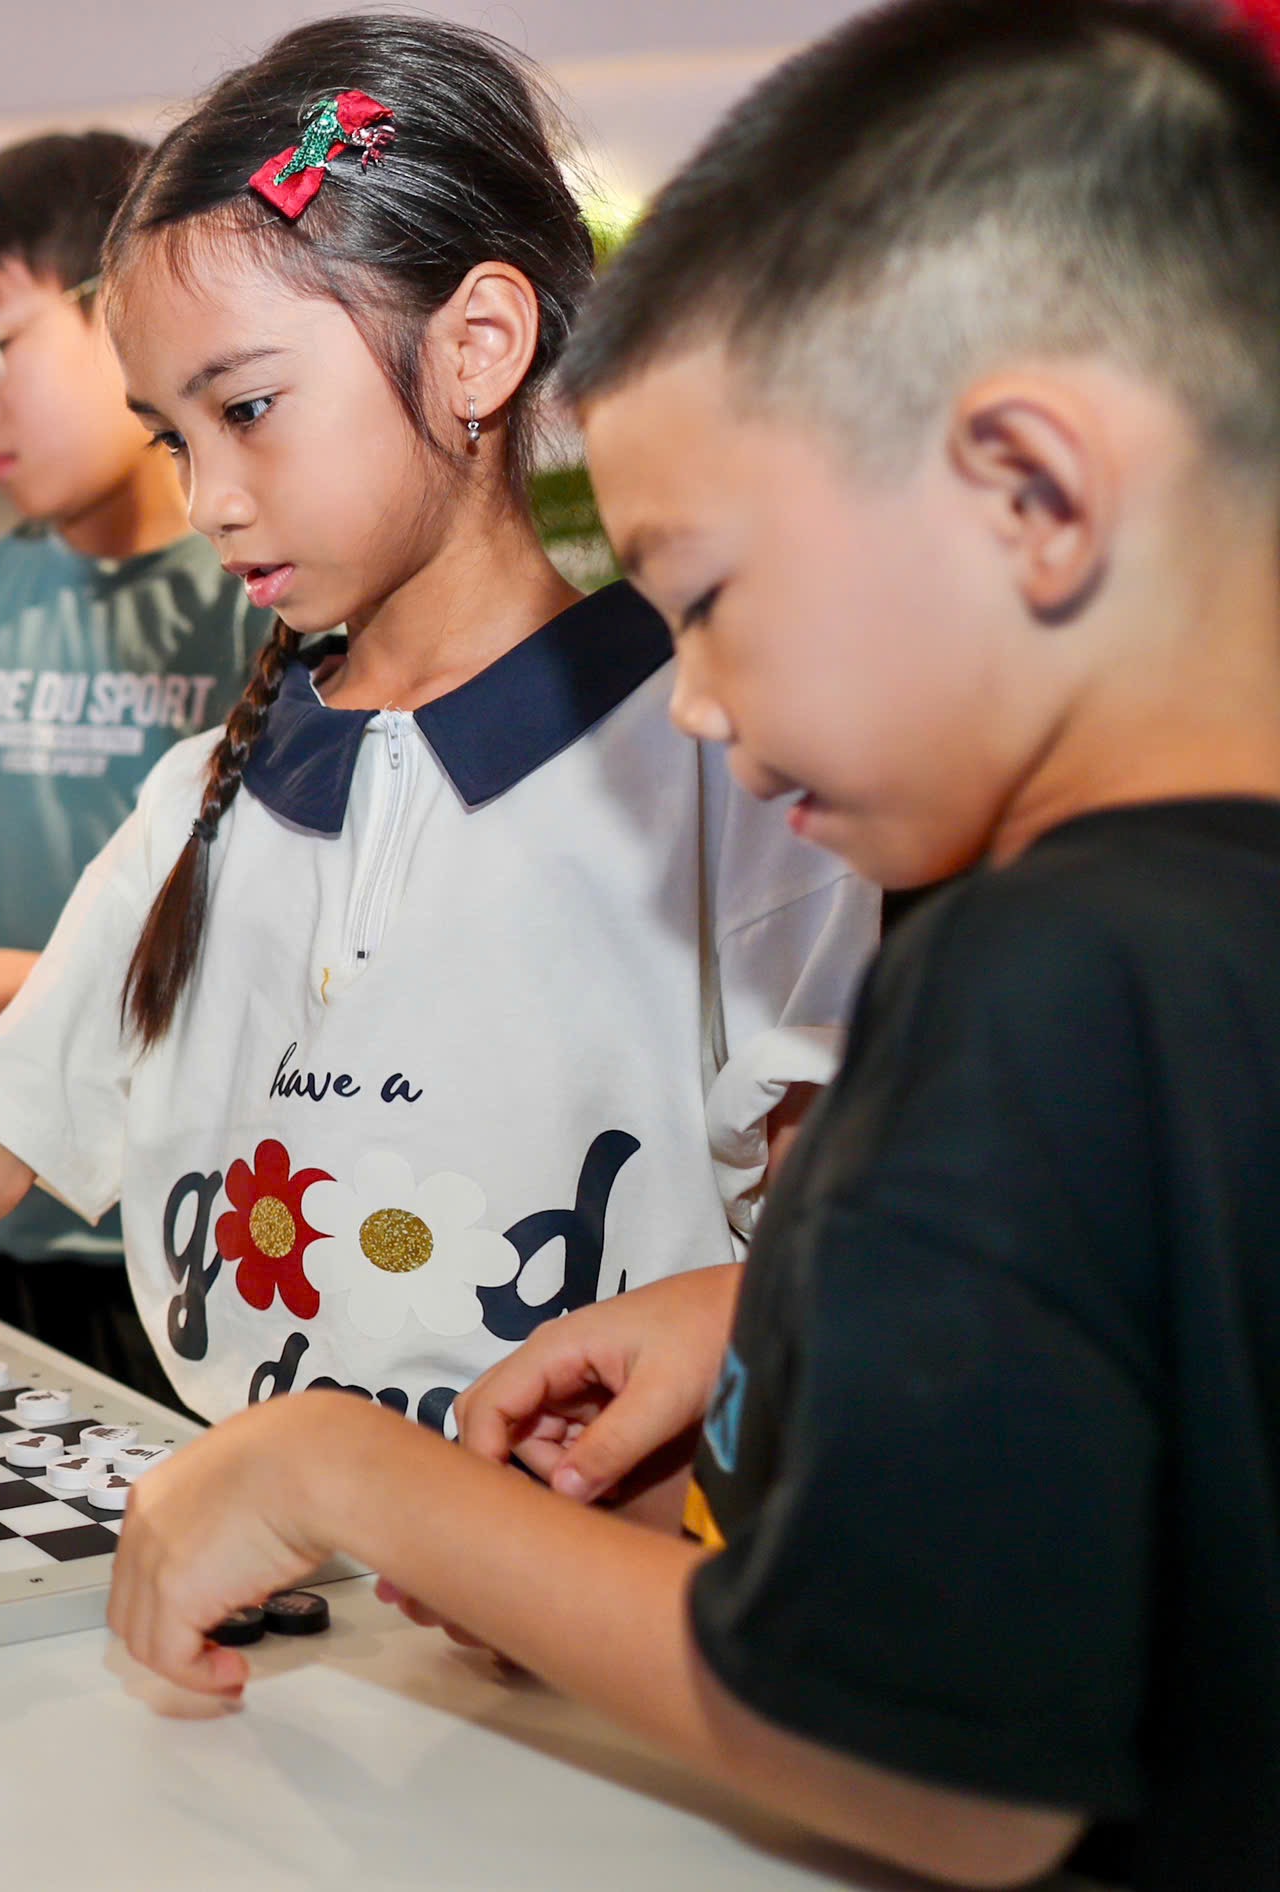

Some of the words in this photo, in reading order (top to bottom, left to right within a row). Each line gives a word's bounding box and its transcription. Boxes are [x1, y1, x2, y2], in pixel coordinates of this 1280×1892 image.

[29, 671, 90, 726] DU
[86, 671, 217, 729] SPORT
[269, 1041, 361, 1102] have
[380, 1072, 423, 1103] a
